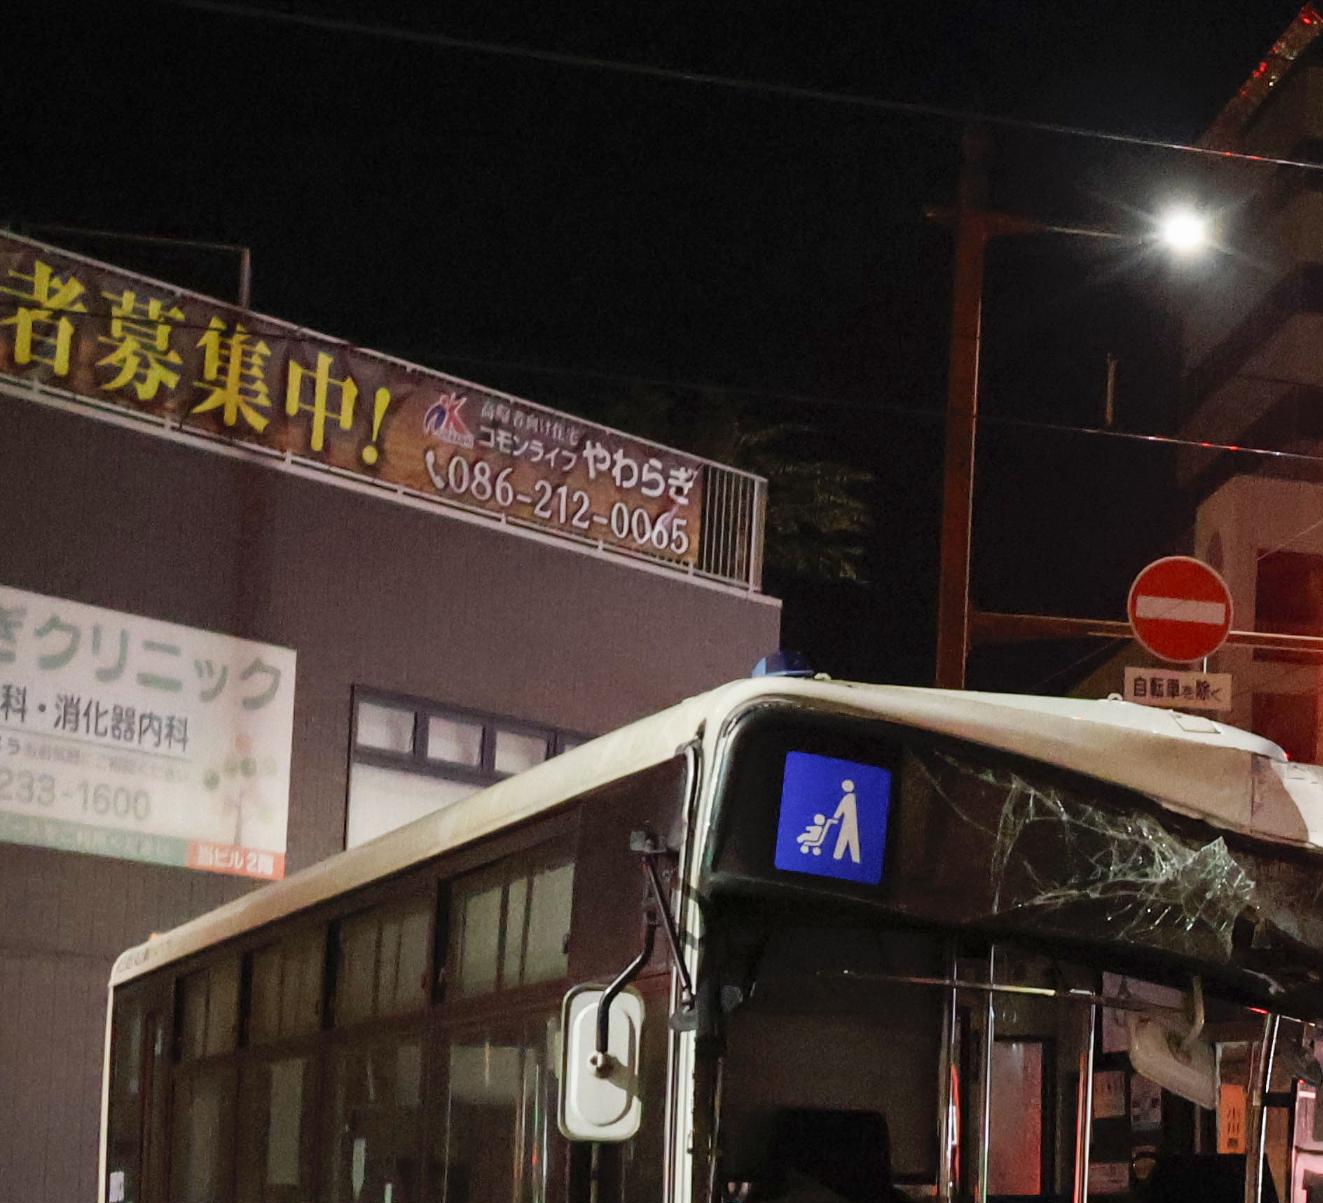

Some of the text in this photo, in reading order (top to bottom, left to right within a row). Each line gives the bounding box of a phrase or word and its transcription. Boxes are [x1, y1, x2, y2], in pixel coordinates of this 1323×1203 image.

[448, 454, 690, 555] 086-212-0065
[478, 424, 578, 471] コモンライフ
[582, 438, 698, 505] やわらぎ
